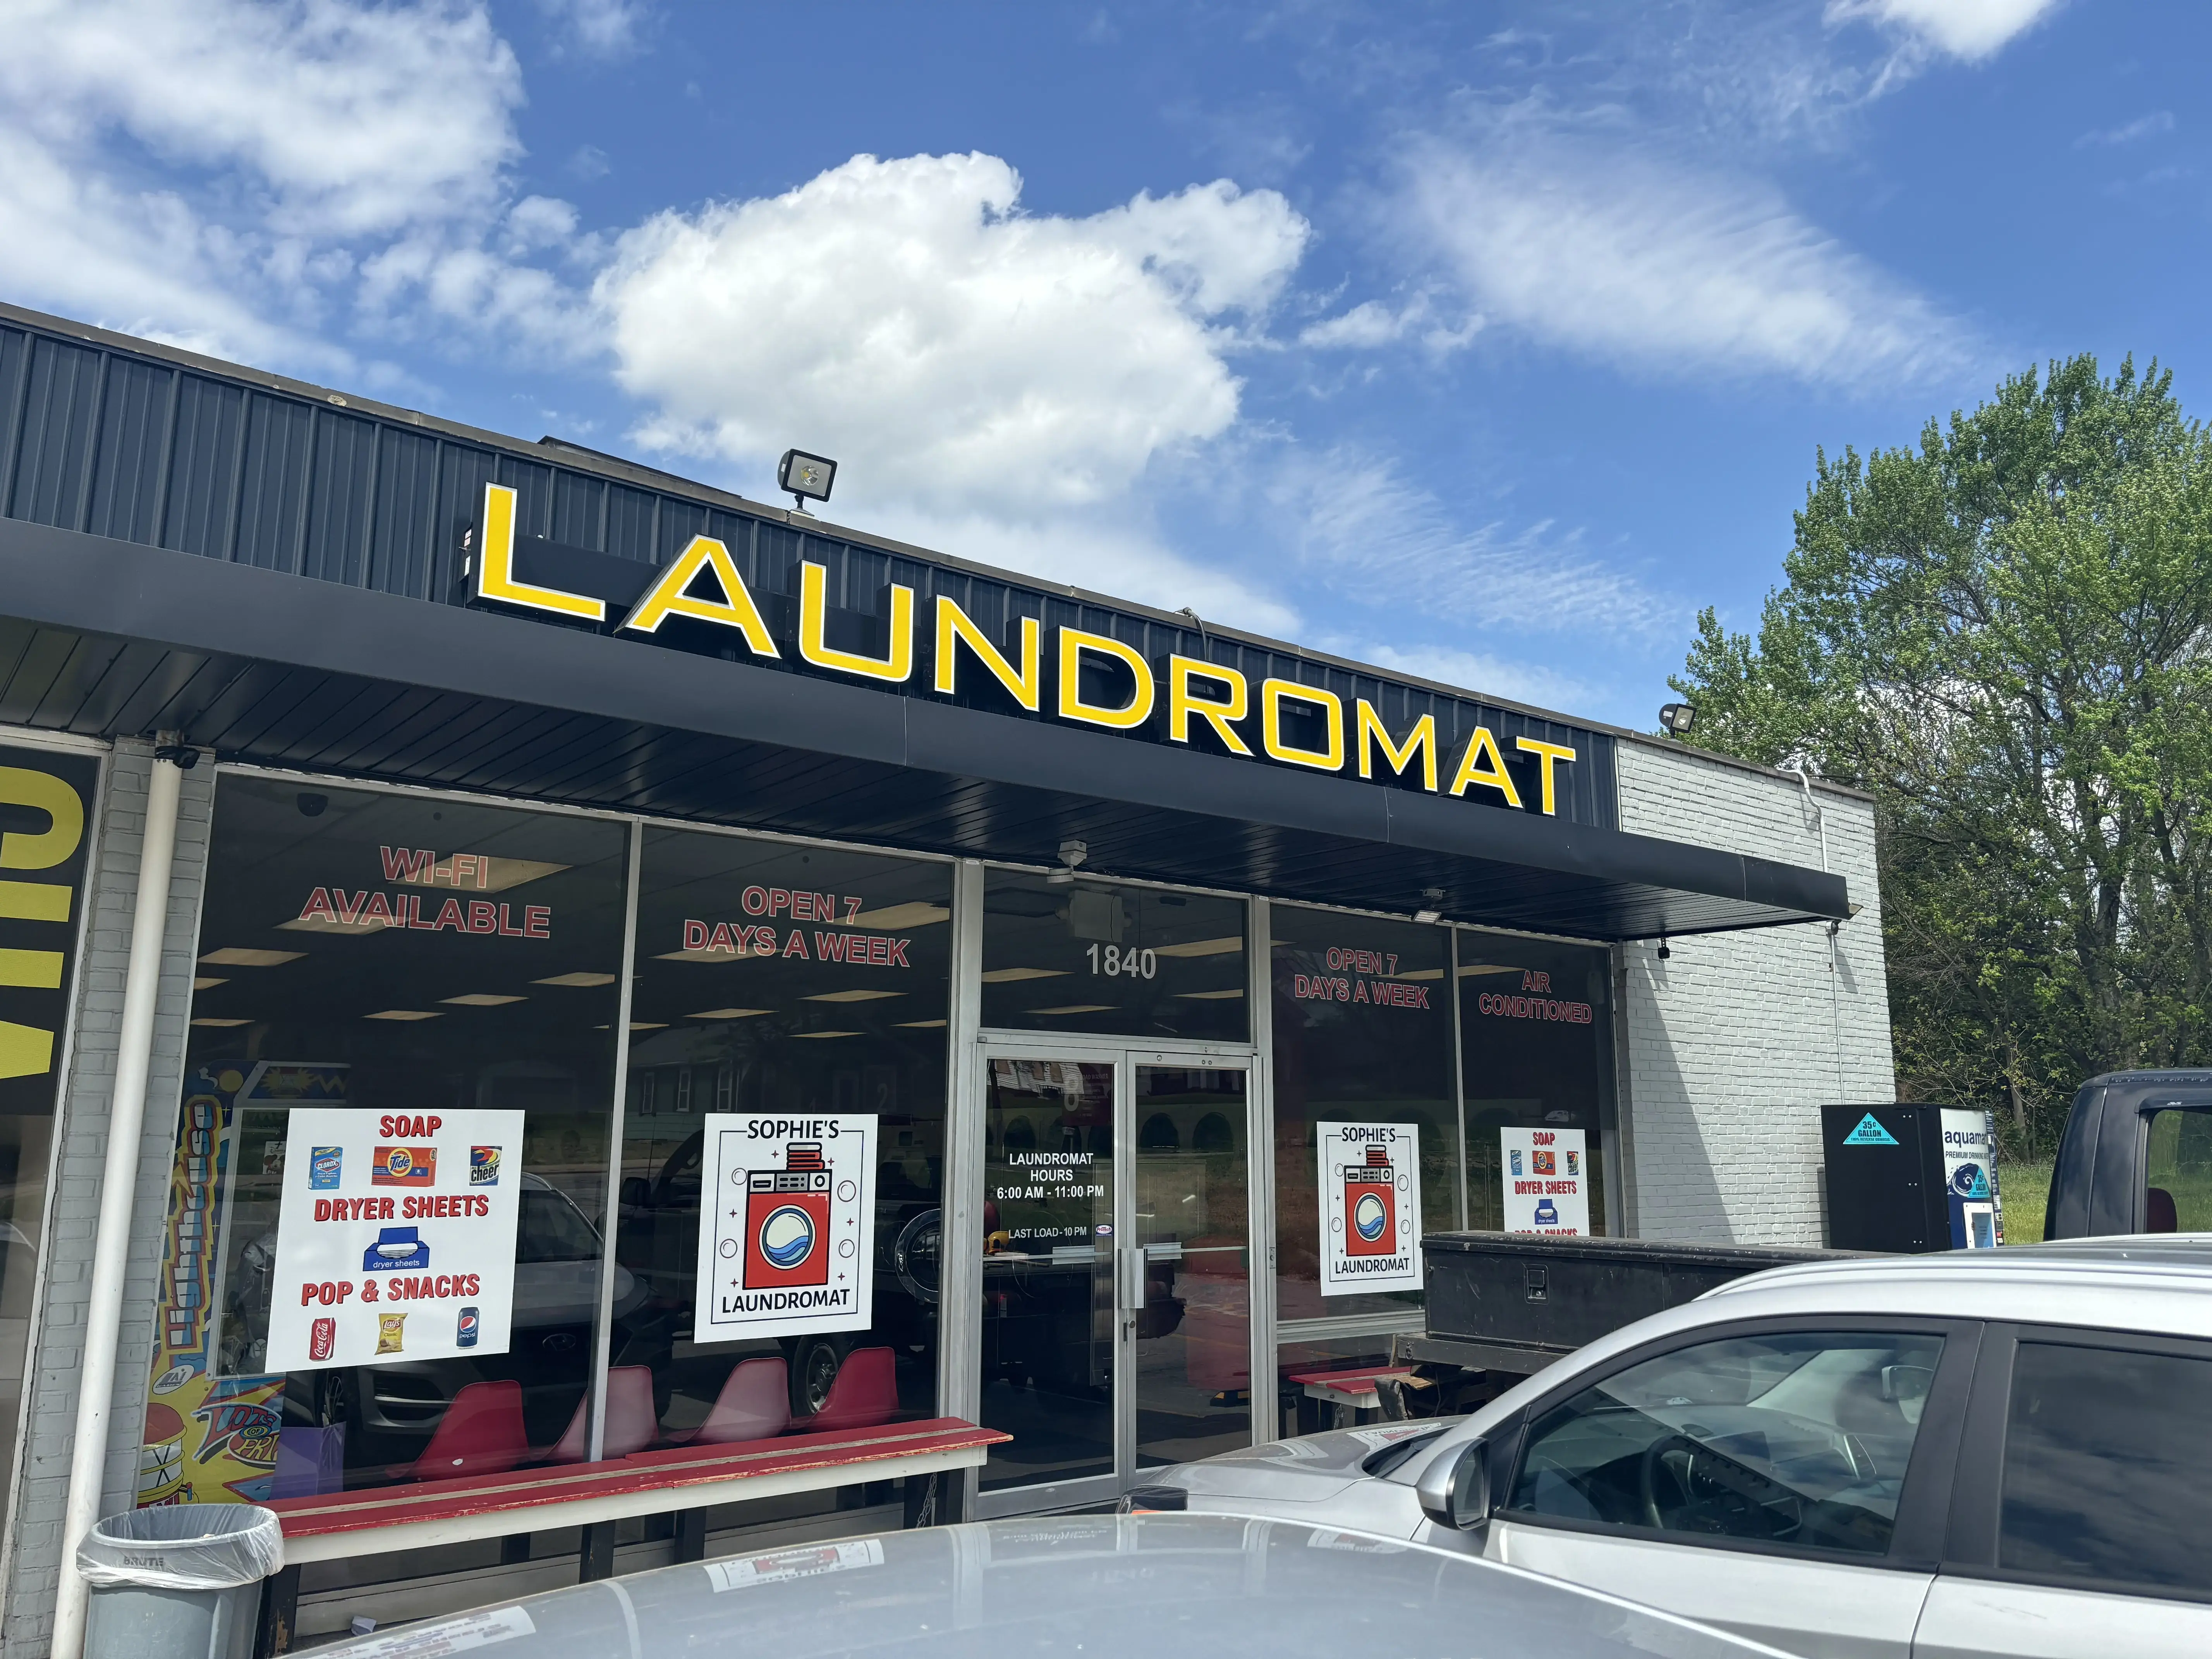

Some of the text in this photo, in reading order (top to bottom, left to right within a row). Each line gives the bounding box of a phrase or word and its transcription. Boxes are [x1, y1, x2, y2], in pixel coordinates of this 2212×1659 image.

[478, 482, 1576, 816] LAUNDROMAT
[380, 846, 488, 888] WI-FI
[298, 887, 551, 938] AVAILABLE
[742, 885, 862, 924] OPEN 7
[684, 919, 911, 967] DAYS A WEEK
[1087, 943, 1156, 979] 1840
[1326, 947, 1398, 976] OPEN 7
[1295, 974, 1430, 1009] DAYS A WEEK
[1522, 970, 1552, 993] AIR
[1479, 993, 1592, 1024] CONDITIONED
[380, 1115, 442, 1137] SOAP
[747, 1120, 839, 1139] SOPHIE'S
[1342, 1127, 1396, 1142] SOPHIE'S
[1533, 1132, 1555, 1146] SOAP
[317, 1160, 338, 1169] CLOROX
[389, 1154, 410, 1172] Tide
[1010, 1153, 1094, 1165] LAUNDROMAT
[471, 1163, 499, 1182] cheer
[1030, 1169, 1073, 1182] HOURS
[997, 1187, 1022, 1199] 6:00
[1024, 1186, 1043, 1199] AM
[1054, 1185, 1084, 1198] 11:00
[1087, 1185, 1104, 1197] PM
[1515, 1180, 1577, 1195] DRYER SHEETS
[314, 1195, 489, 1221] DRYER SHEETS
[170, 1103, 213, 1345] Lighthouse
[1008, 1228, 1032, 1239] LAST
[1074, 1226, 1087, 1236] PM
[1335, 1257, 1410, 1274] LAUNDROMAT
[301, 1273, 480, 1306] POP & SNACKS
[723, 1289, 850, 1313] LAUNDROMAT
[124, 1555, 164, 1567] BRUTE
